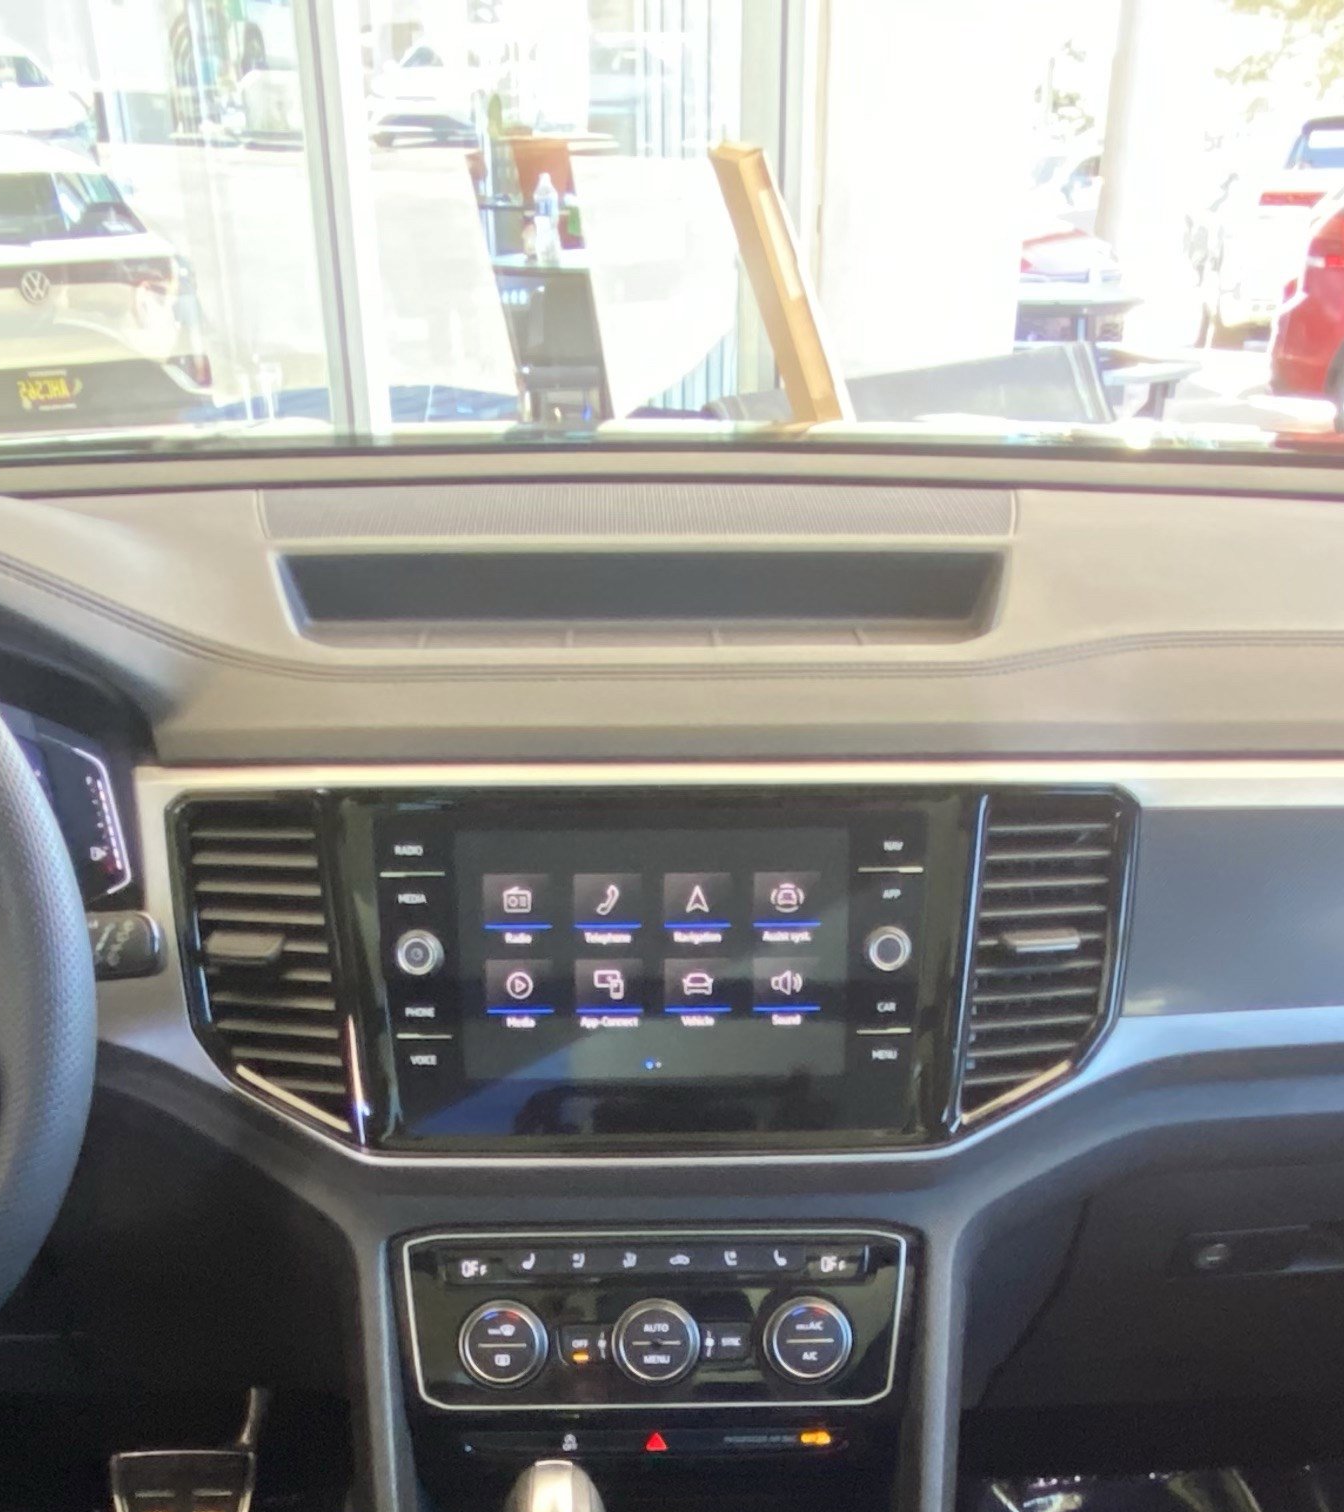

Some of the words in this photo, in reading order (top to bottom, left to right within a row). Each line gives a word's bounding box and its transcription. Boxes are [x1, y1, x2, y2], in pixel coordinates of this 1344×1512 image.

[394, 844, 423, 856] RADIO
[883, 841, 904, 851] NAV
[397, 893, 426, 904] MEDIA
[882, 889, 901, 899] APP
[504, 932, 532, 944] Radio
[584, 932, 632, 945] Telephone
[673, 931, 722, 945] Navigation
[404, 1006, 435, 1018] PHONE
[877, 1001, 897, 1013] CAR
[506, 1016, 536, 1028] Media
[681, 1015, 715, 1027] Vehicle
[771, 1013, 802, 1026] Sound
[409, 1054, 437, 1066] VOICE
[871, 1049, 898, 1060] MENU
[643, 1323, 670, 1333] AUTO
[571, 1339, 589, 1349] OFF
[643, 1354, 671, 1364] MENU
